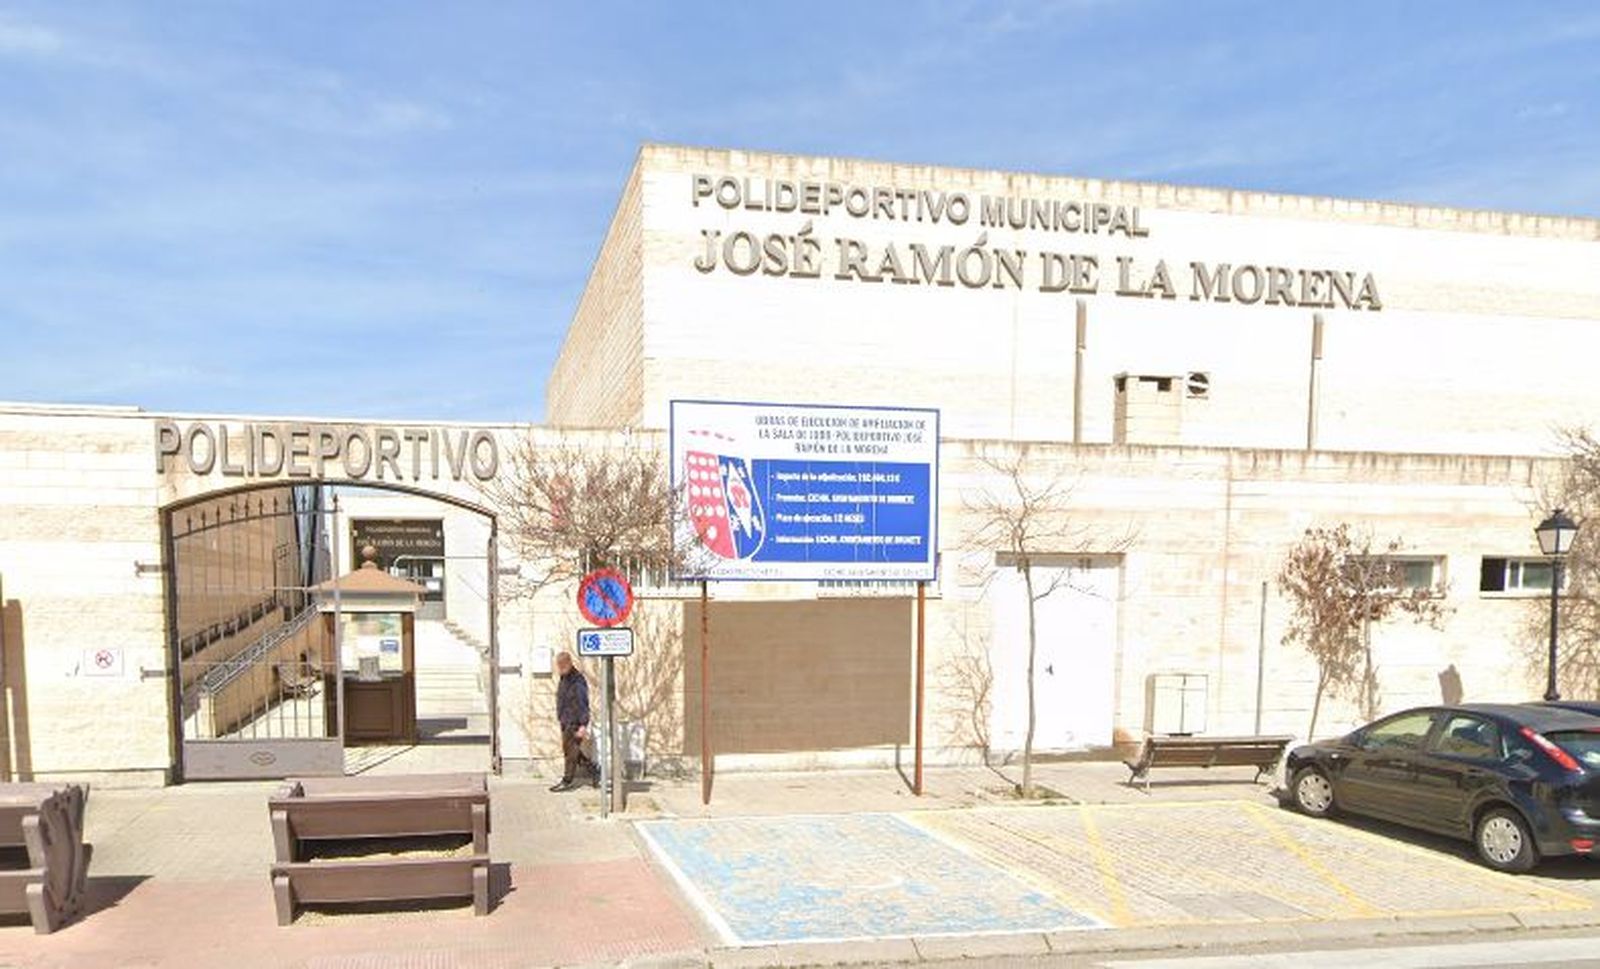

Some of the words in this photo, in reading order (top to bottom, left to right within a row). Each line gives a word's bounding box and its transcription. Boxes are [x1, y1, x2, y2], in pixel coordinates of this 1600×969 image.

[692, 173, 970, 225] POLIDEPORTIVO
[980, 194, 1149, 238] MUNICIPAL
[694, 219, 821, 278] JOSÉ
[834, 231, 1027, 290] RAMÓN
[1038, 251, 1099, 295] DE
[1115, 255, 1176, 300] LA
[1190, 261, 1382, 311] MORENA
[154, 420, 499, 480] POLIDEPORTIVO
